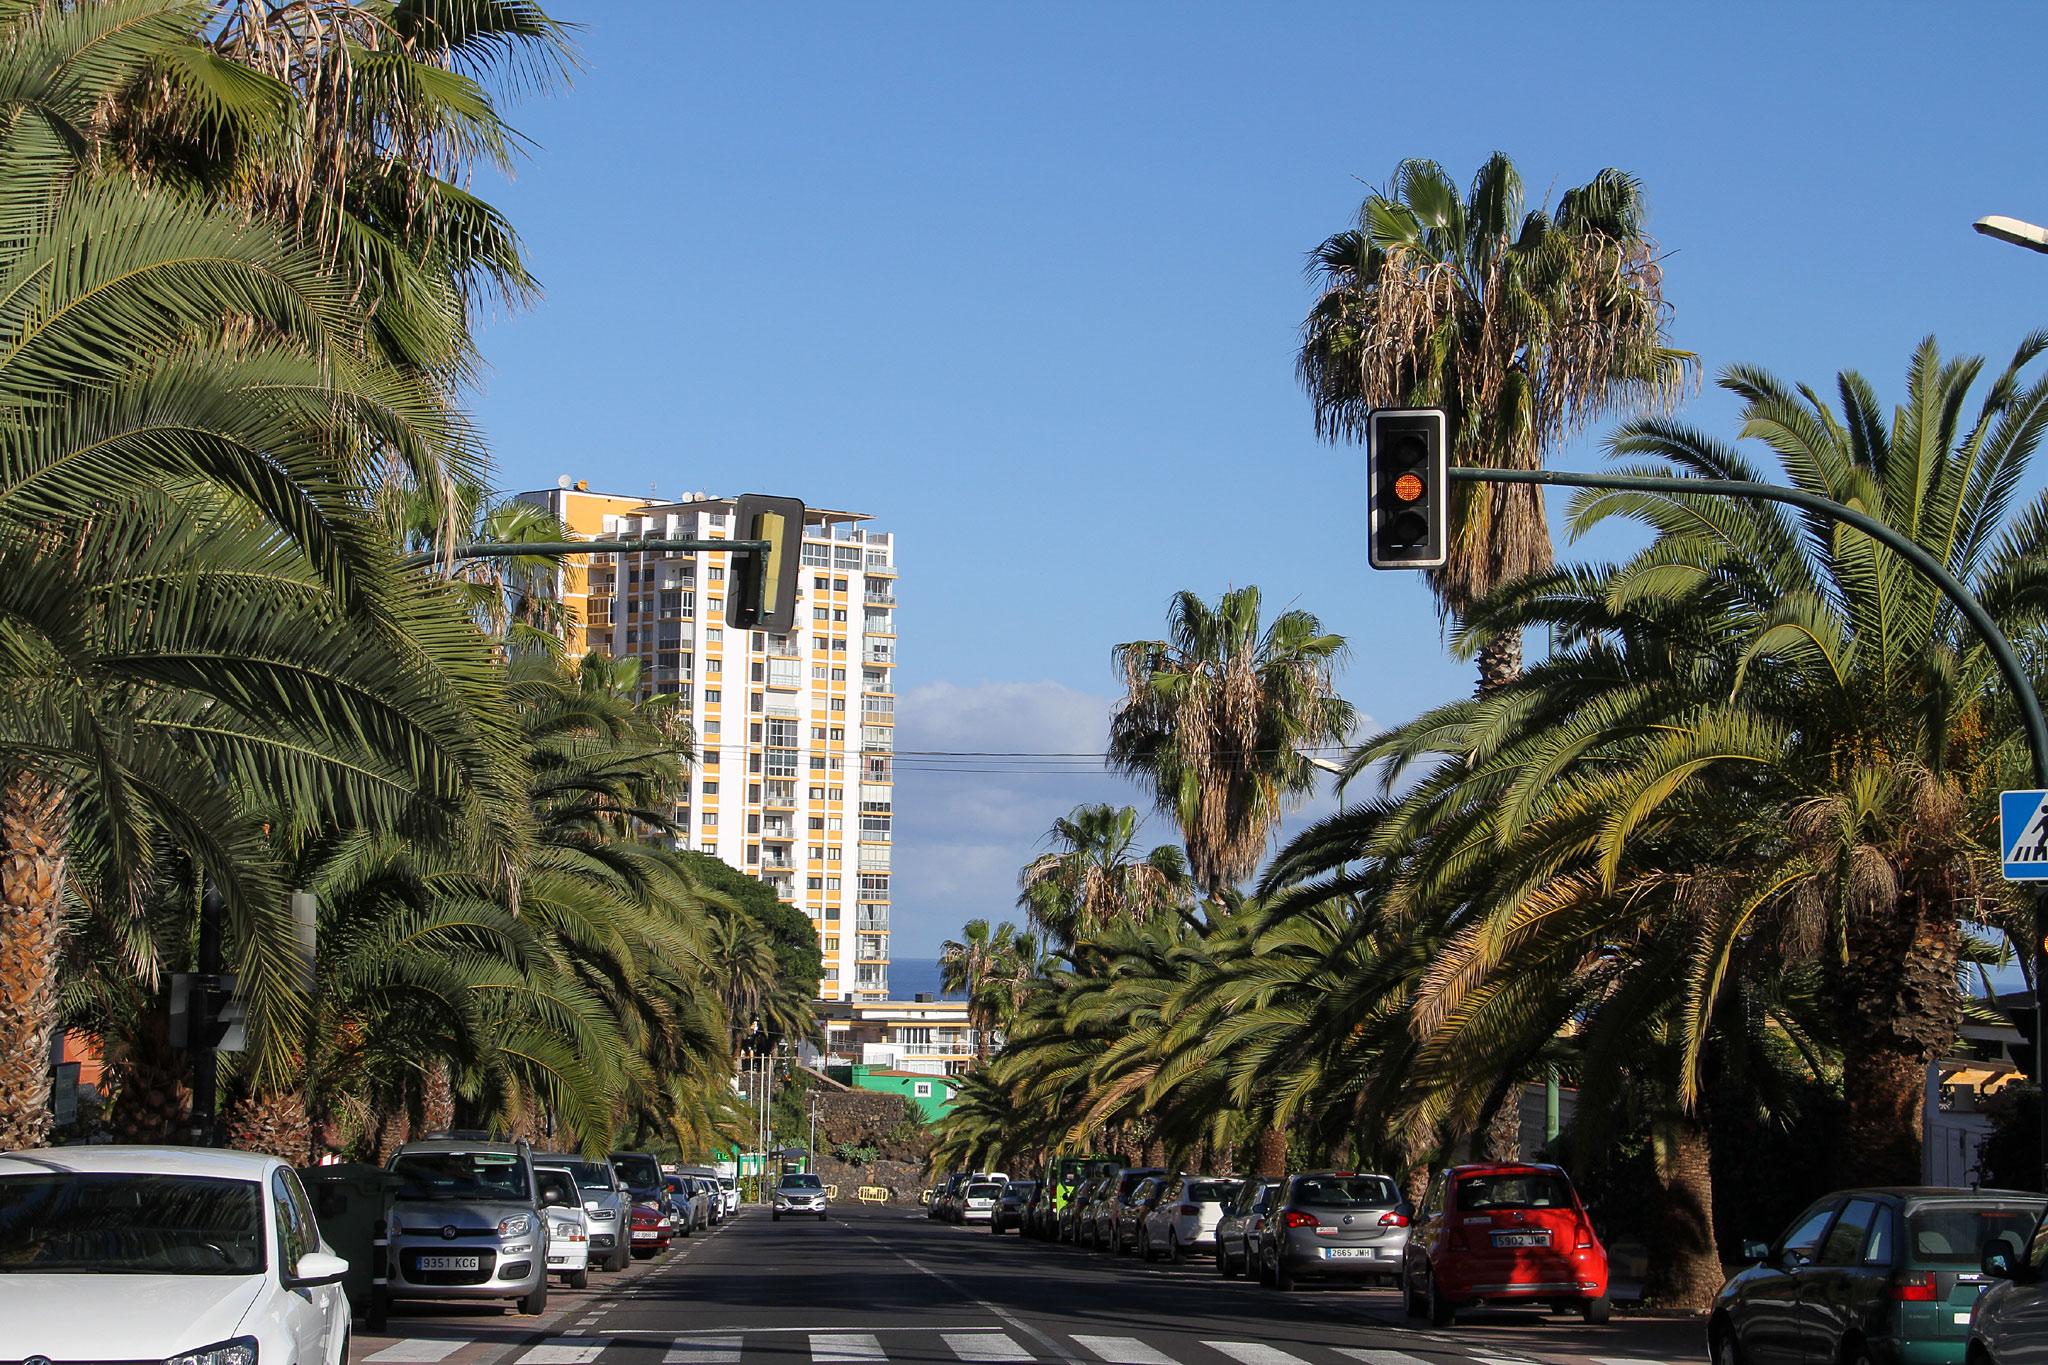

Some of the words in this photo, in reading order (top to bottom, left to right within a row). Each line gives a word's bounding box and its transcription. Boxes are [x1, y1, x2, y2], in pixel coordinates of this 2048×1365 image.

[1498, 1236, 1524, 1246] 5902
[1332, 1249, 1351, 1257] 2665
[423, 1258, 450, 1268] 9351
[455, 1258, 476, 1268] KCG
